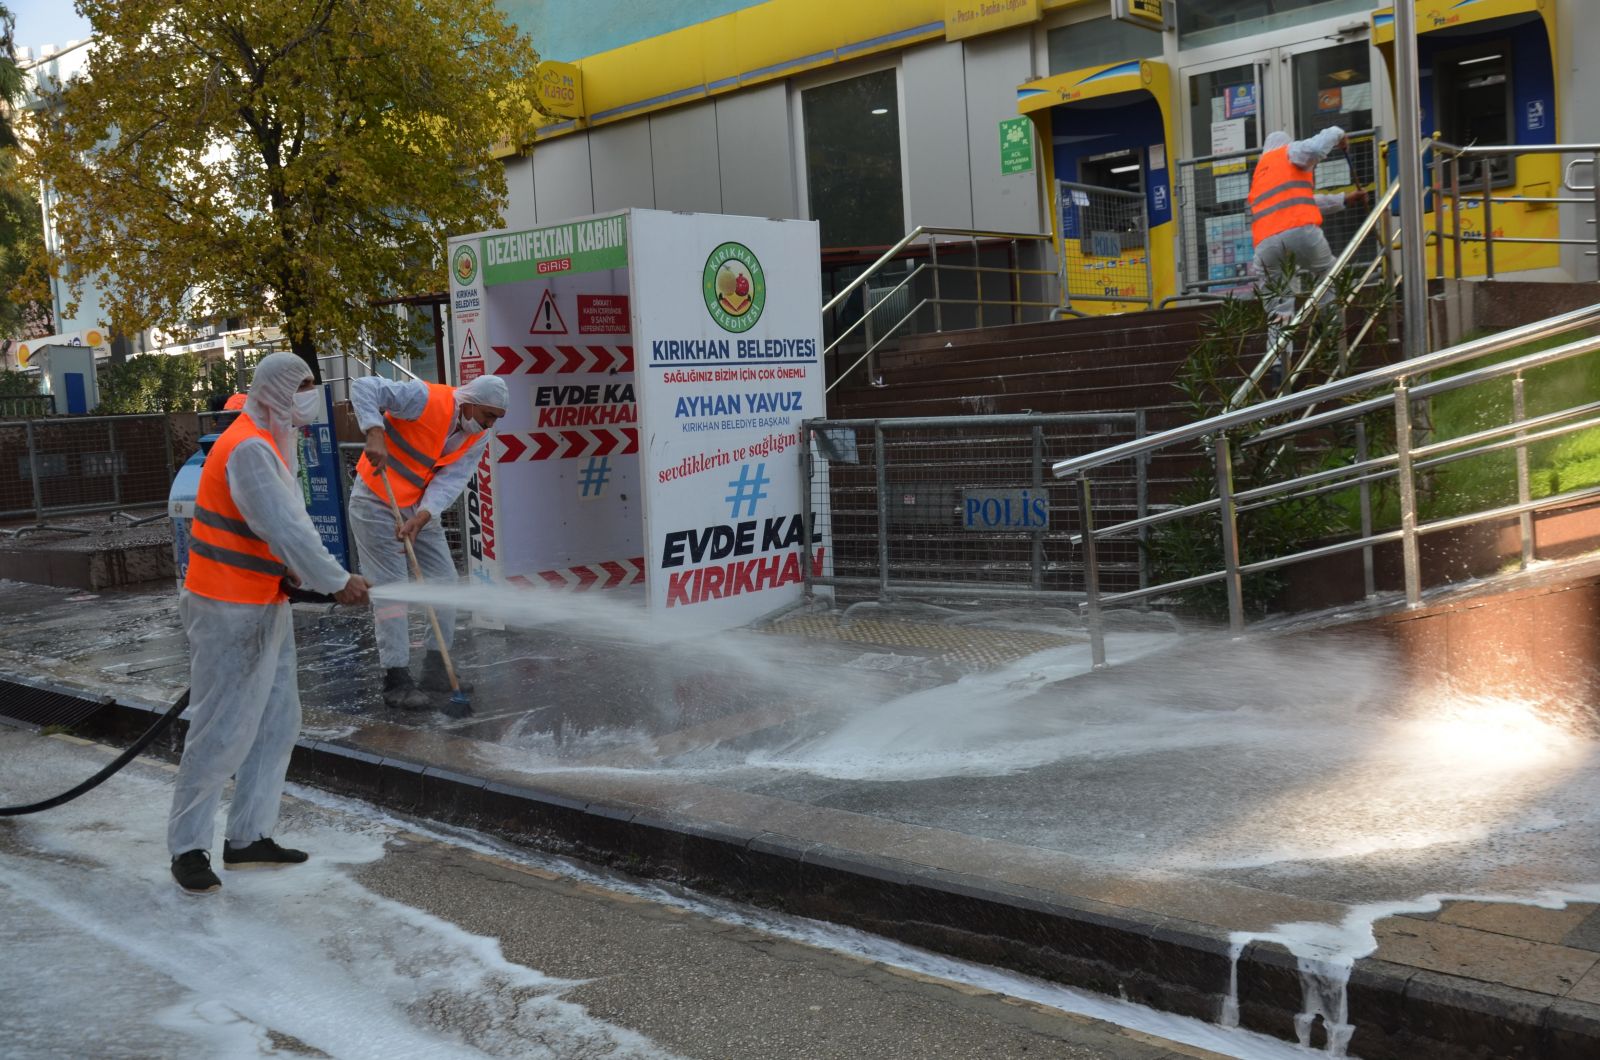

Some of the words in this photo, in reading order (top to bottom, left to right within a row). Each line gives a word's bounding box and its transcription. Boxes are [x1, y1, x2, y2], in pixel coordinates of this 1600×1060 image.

[486, 226, 574, 266] DEZENFEKTAN
[709, 248, 758, 274] KIRIKHAN
[456, 289, 478, 299] KIRIKHAN
[652, 340, 730, 361] KIRIKHAN
[663, 369, 713, 384] SAĞLIĞINIZ
[715, 368, 738, 382] BİZİM
[739, 367, 757, 383] İÇİN
[758, 370, 775, 383] ÇOK
[777, 365, 806, 379] ÖNEMLİ
[535, 386, 600, 407] EVDE
[603, 383, 636, 403] KA
[675, 394, 741, 418] AYHAN
[744, 391, 803, 413] YAVUZ
[682, 422, 720, 433] KIRIKHAN
[759, 416, 790, 428] BAŞKANI
[658, 449, 730, 484] sevdiklerin
[733, 448, 746, 461] ve
[748, 431, 796, 458] sağlığın
[966, 490, 1048, 528] POLİS
[661, 520, 757, 569] EVDE
[761, 511, 823, 552] KAL
[665, 547, 825, 608] KIRIKHAN
